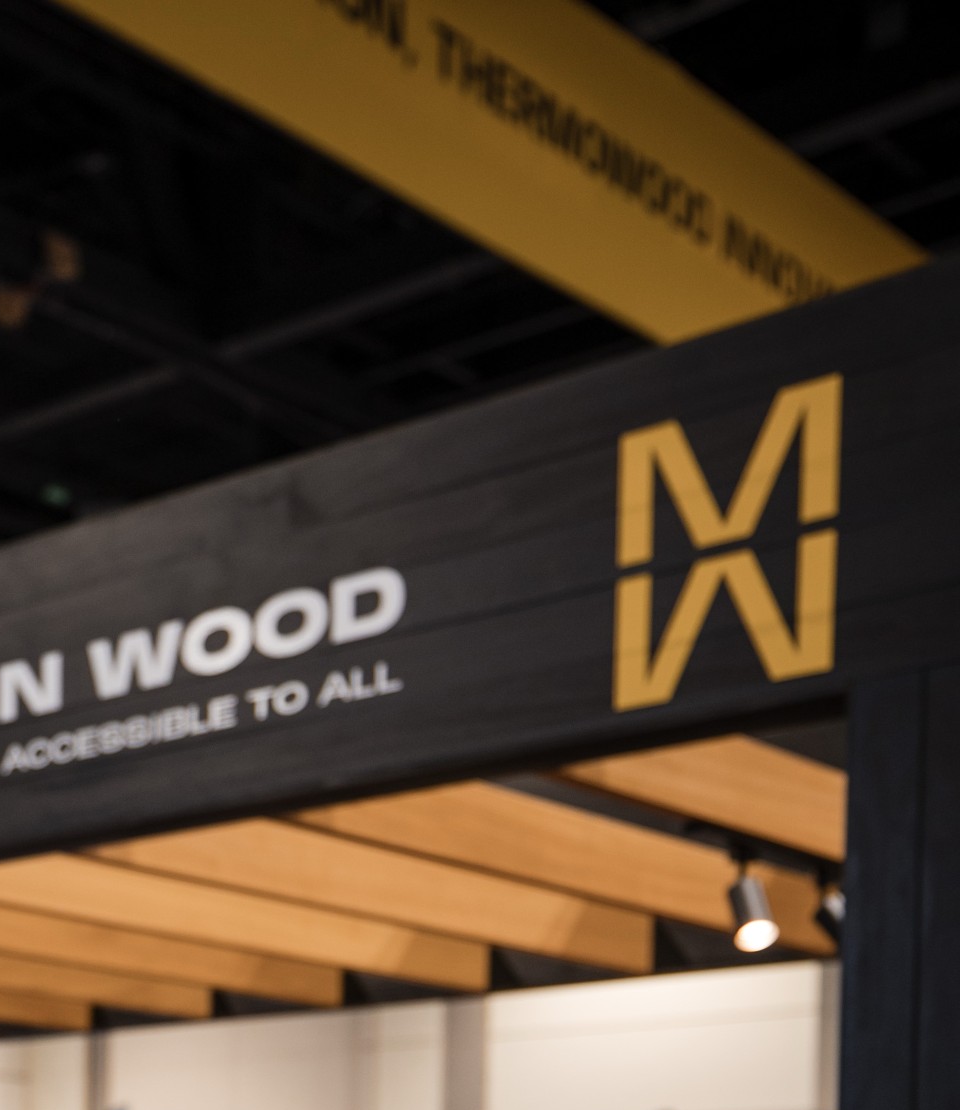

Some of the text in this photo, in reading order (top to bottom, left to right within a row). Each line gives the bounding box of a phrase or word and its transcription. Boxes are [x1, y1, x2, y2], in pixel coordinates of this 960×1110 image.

[87, 565, 407, 699] WOOD
[247, 679, 310, 722] TO
[316, 659, 405, 709] ALL
